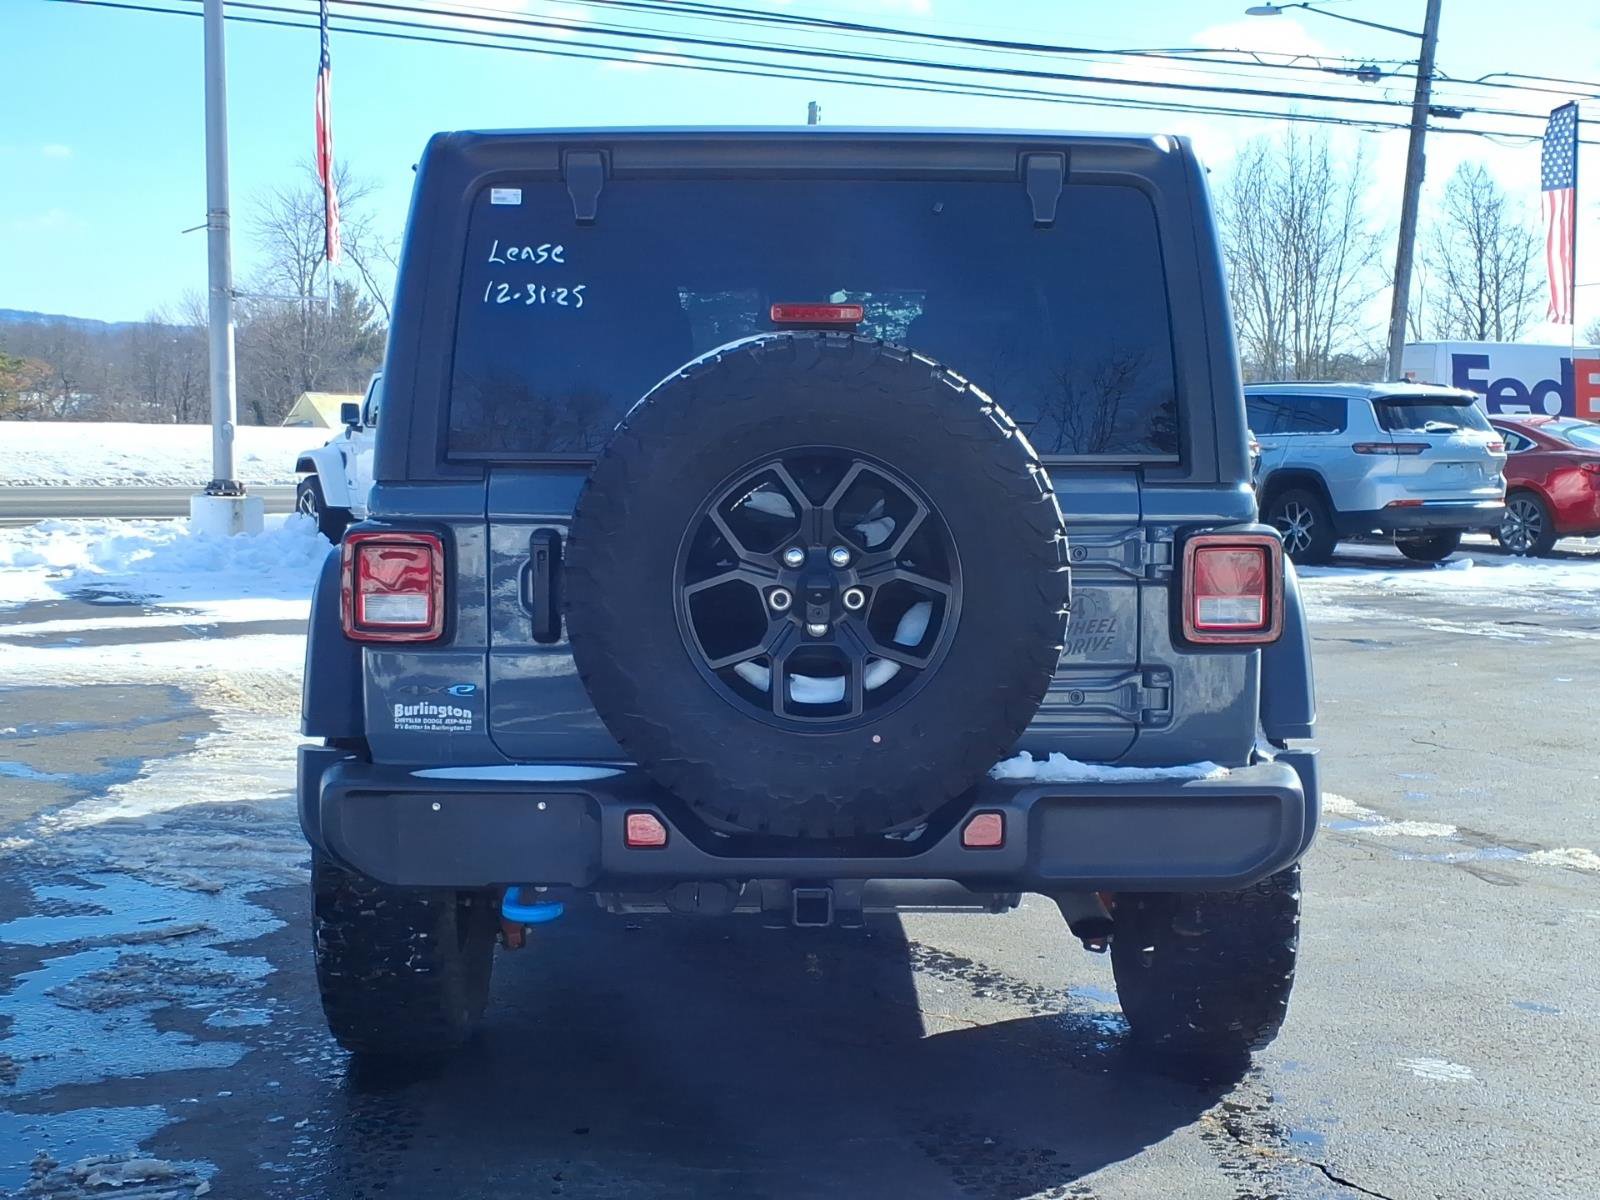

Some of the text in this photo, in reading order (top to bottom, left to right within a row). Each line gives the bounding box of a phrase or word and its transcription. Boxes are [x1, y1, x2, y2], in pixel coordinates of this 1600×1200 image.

[488, 240, 565, 264] Lease
[1069, 617, 1117, 636] HEEL
[394, 702, 472, 718] Burlington
